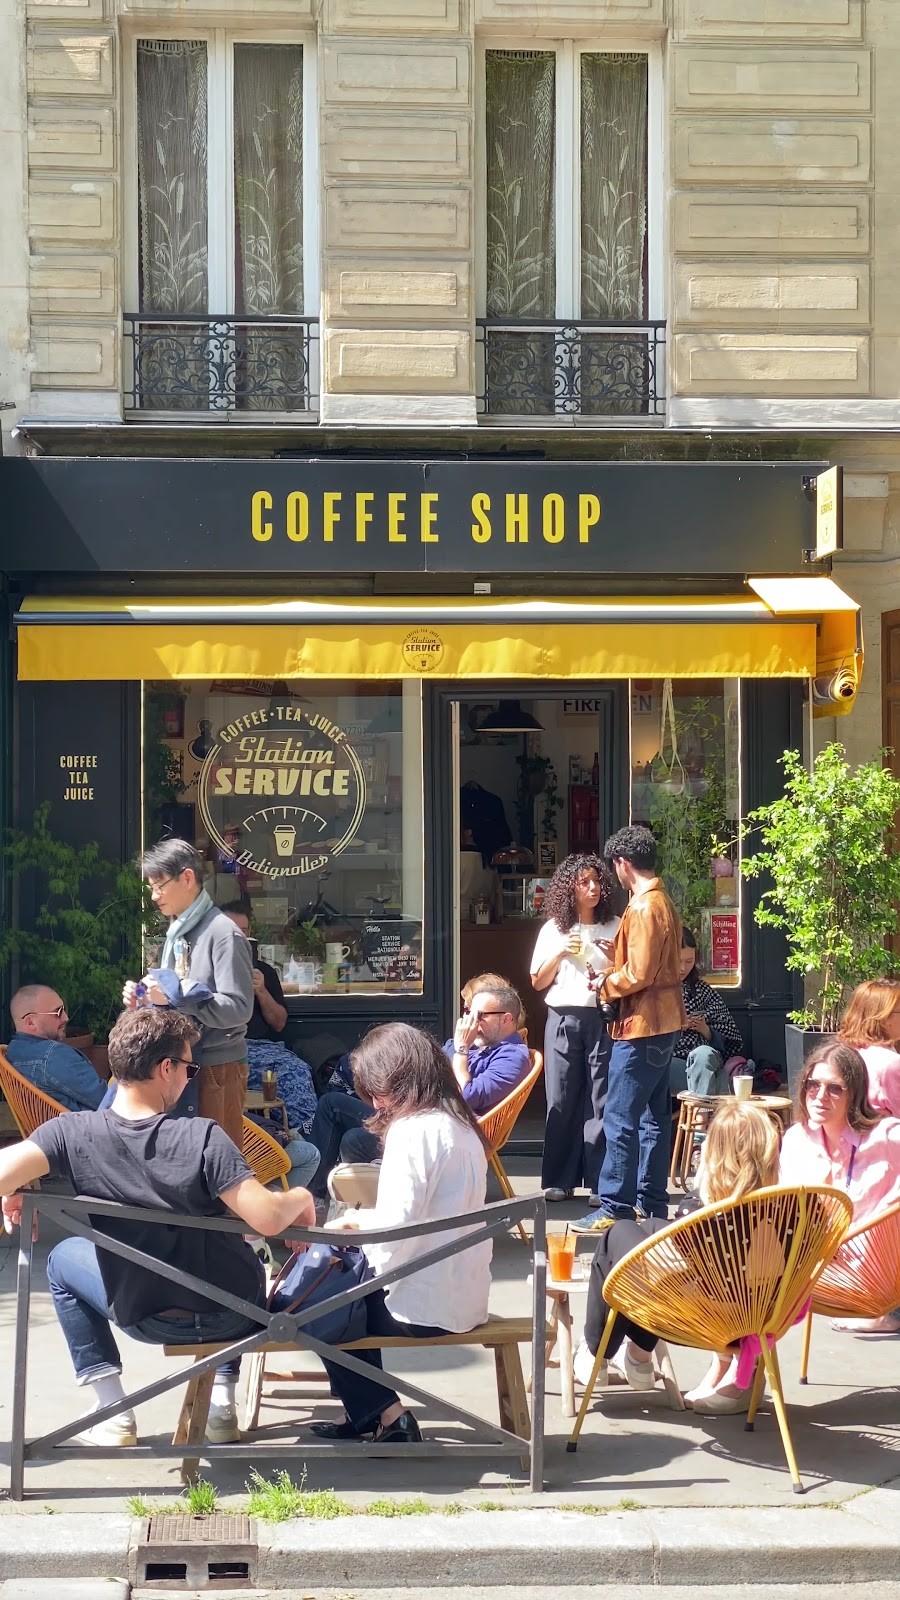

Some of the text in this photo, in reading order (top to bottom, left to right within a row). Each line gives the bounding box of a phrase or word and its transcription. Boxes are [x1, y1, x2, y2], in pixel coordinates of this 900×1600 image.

[251, 491, 601, 544] COFFEE SHOP
[219, 706, 347, 745] COFFEE TEA JUICE
[60, 755, 98, 768] COFFEE
[234, 736, 336, 765] Station
[69, 771, 89, 784] TEA
[214, 767, 350, 796] SERVICE
[63, 787, 94, 800] JUICE
[236, 848, 329, 880] Batignolles
